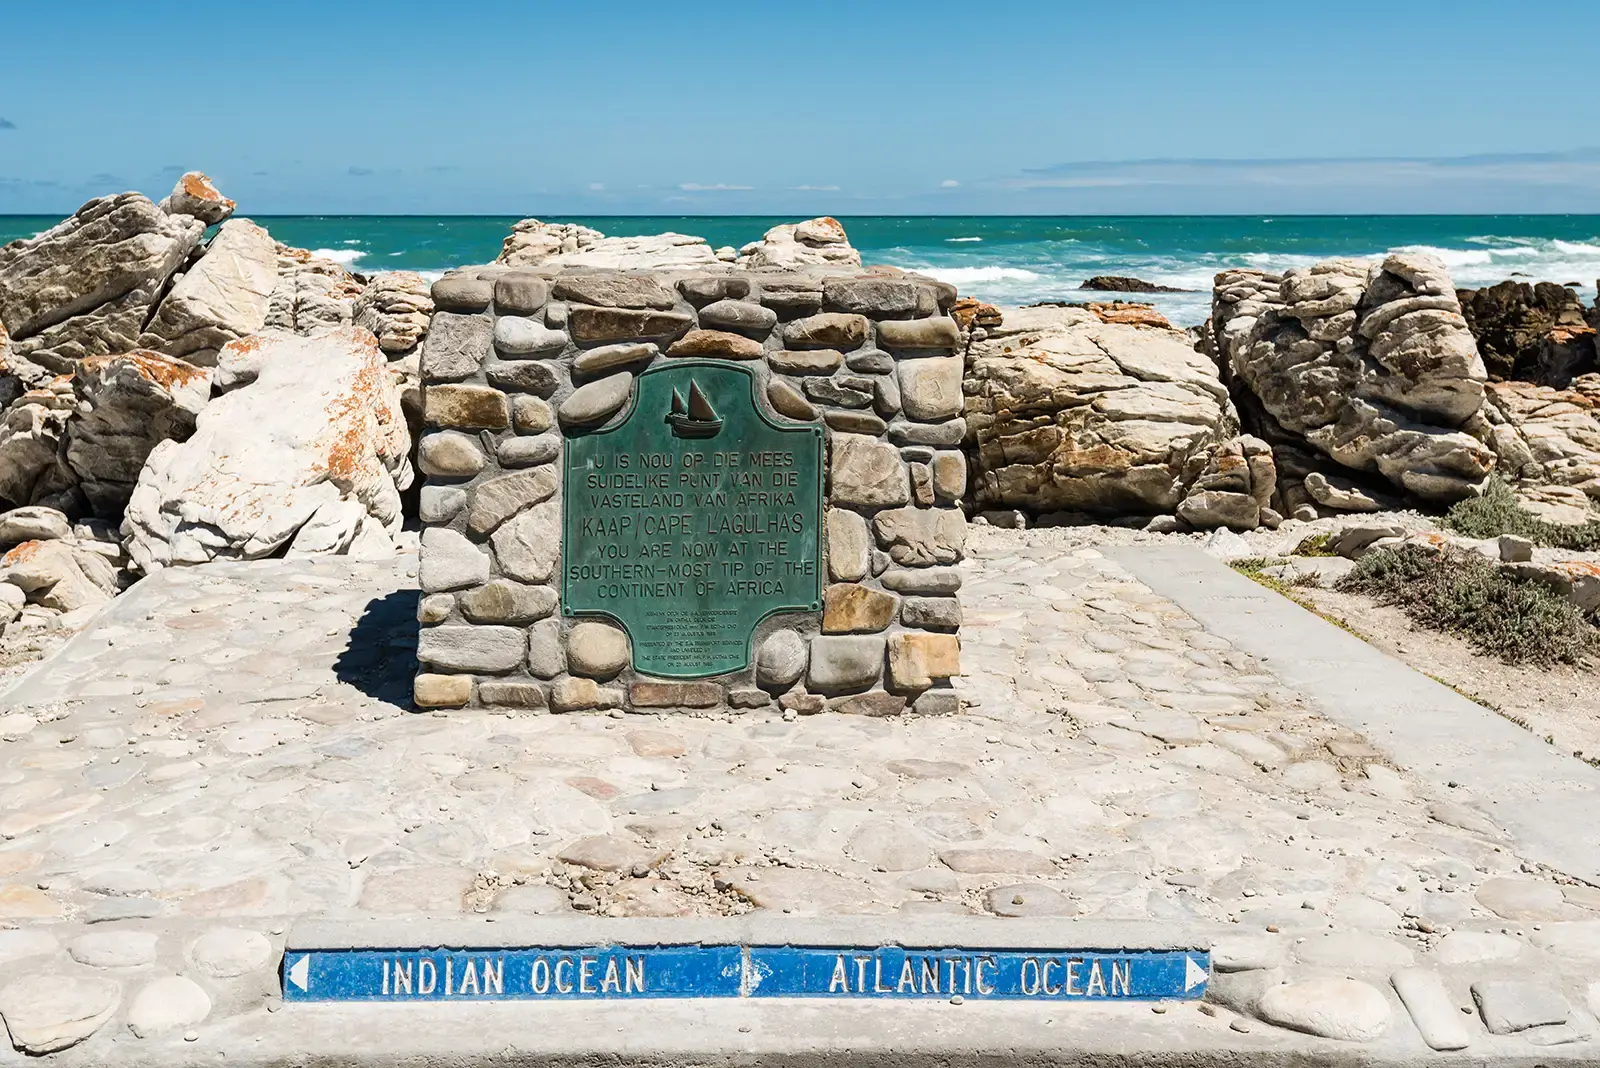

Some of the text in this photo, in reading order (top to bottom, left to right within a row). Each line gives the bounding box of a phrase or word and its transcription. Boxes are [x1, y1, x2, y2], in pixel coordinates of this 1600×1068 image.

[594, 452, 794, 469] U IS NOU OP DIE MEES
[587, 472, 799, 489] SUIDELIKE PUNT VAN DIE
[591, 492, 796, 509] VASTELAND VAN AFRIKA
[582, 513, 693, 539] KAAP/CAPE
[597, 541, 789, 559] YOU ARE NOW AT THE
[721, 563, 744, 577] TIP
[754, 562, 775, 576] OF
[784, 561, 815, 576] THE
[598, 580, 786, 599] CONTINENT OF AFRICA
[381, 955, 646, 995] INDIAN OCEAN
[828, 954, 1132, 997] ATLANTIC OCEAN
